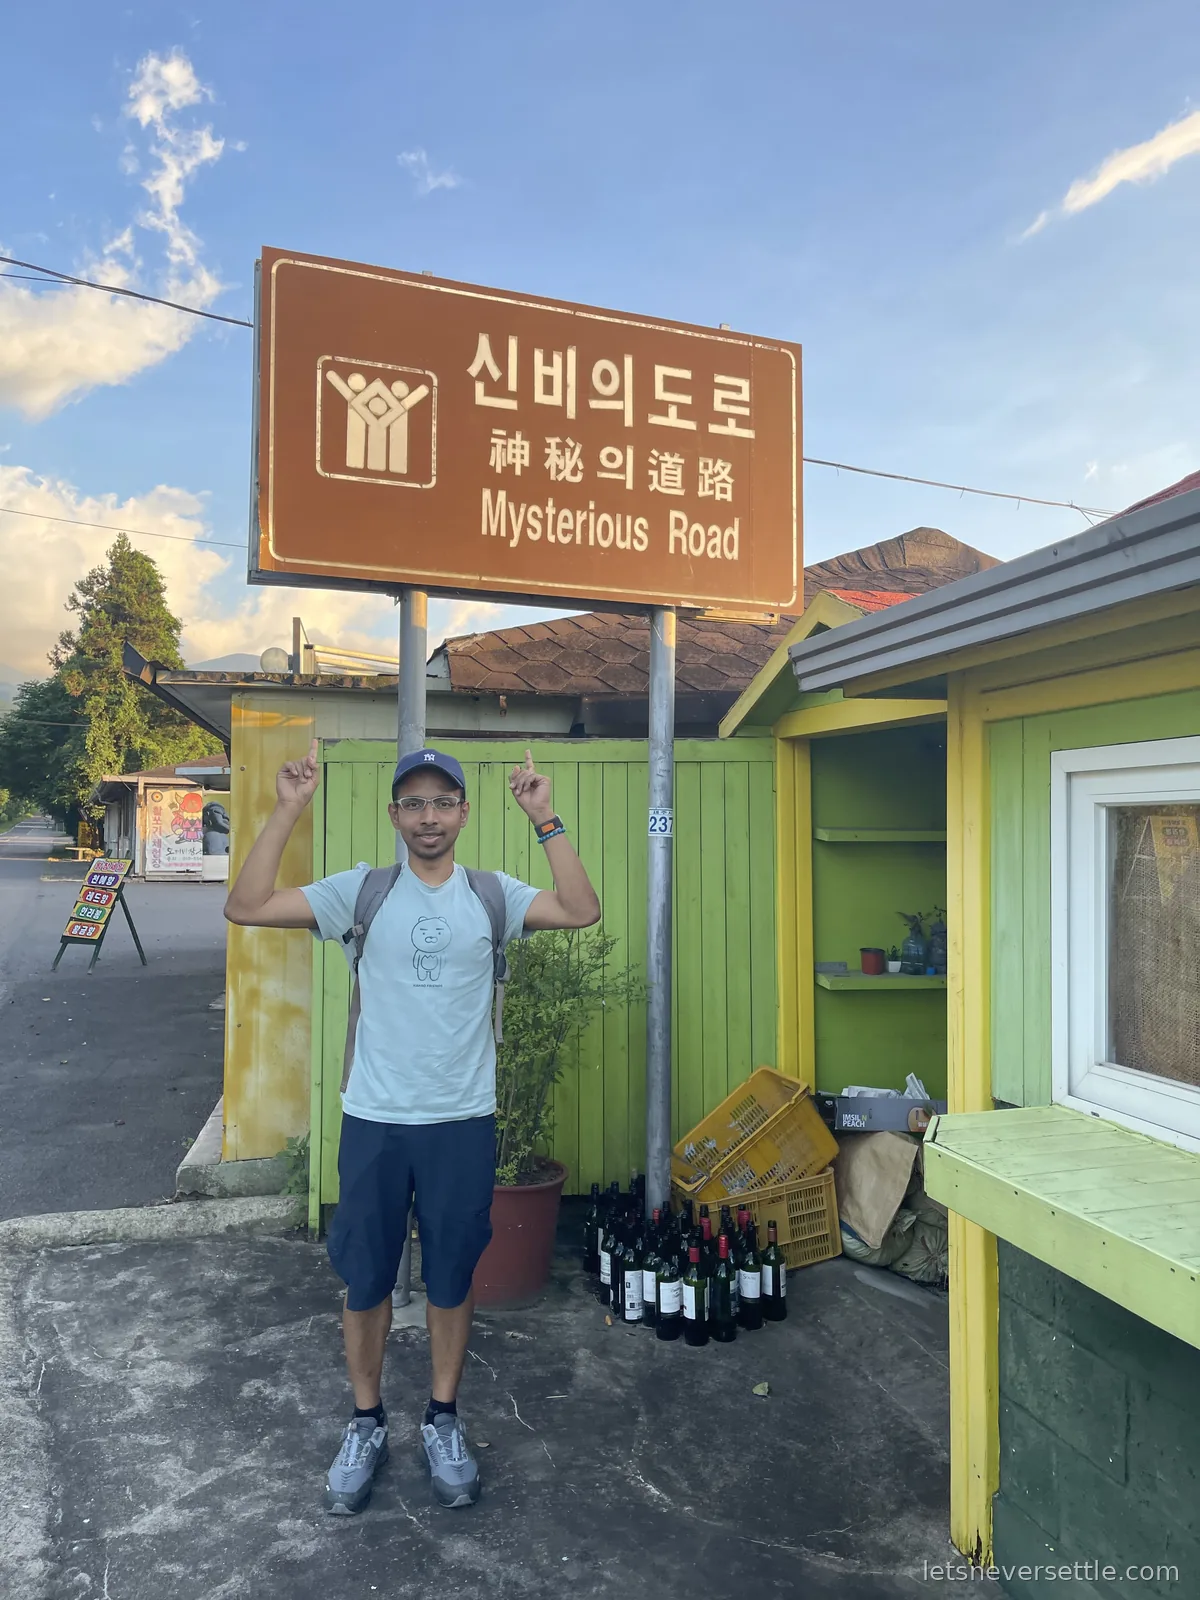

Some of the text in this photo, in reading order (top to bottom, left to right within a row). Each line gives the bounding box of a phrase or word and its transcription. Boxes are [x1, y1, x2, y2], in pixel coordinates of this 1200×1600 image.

[481, 488, 740, 561] Mysterious Road
[842, 1120, 865, 1128] PEACH
